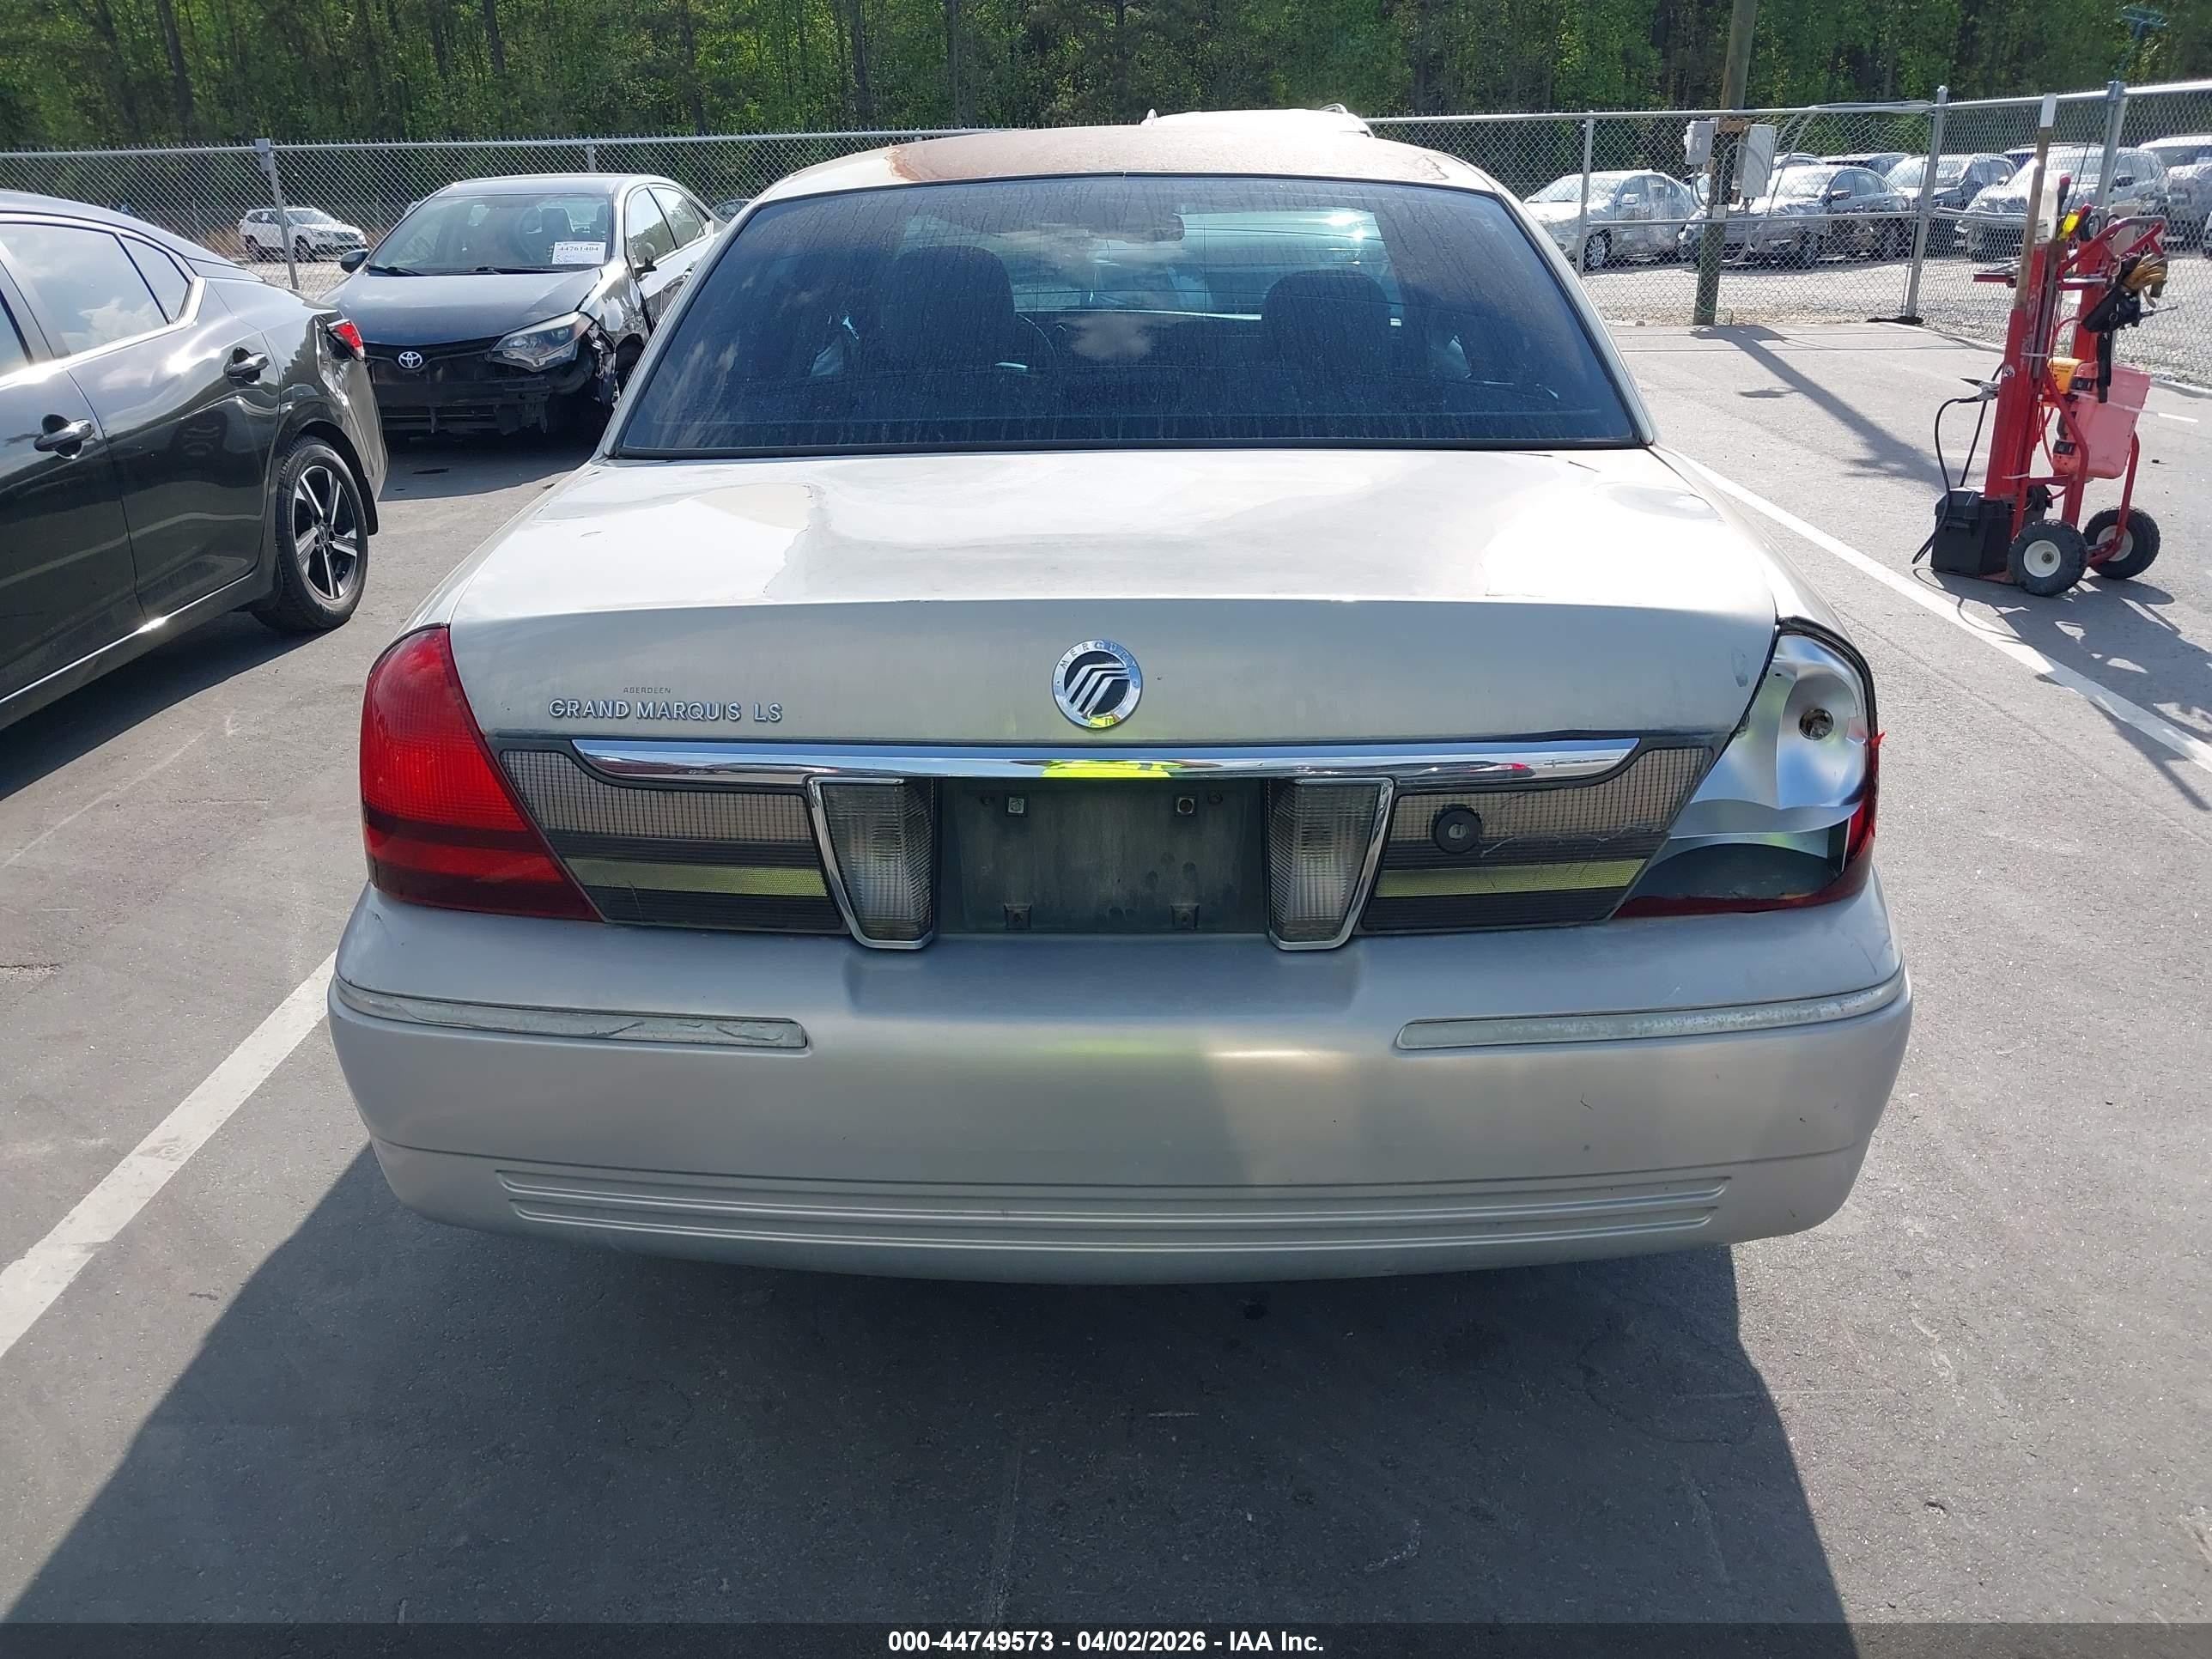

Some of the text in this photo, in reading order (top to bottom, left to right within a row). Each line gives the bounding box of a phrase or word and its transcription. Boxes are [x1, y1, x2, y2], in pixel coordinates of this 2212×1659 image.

[1060, 641, 1136, 668] MERCURY
[549, 699, 783, 723] GRAND MARQUIS LS
